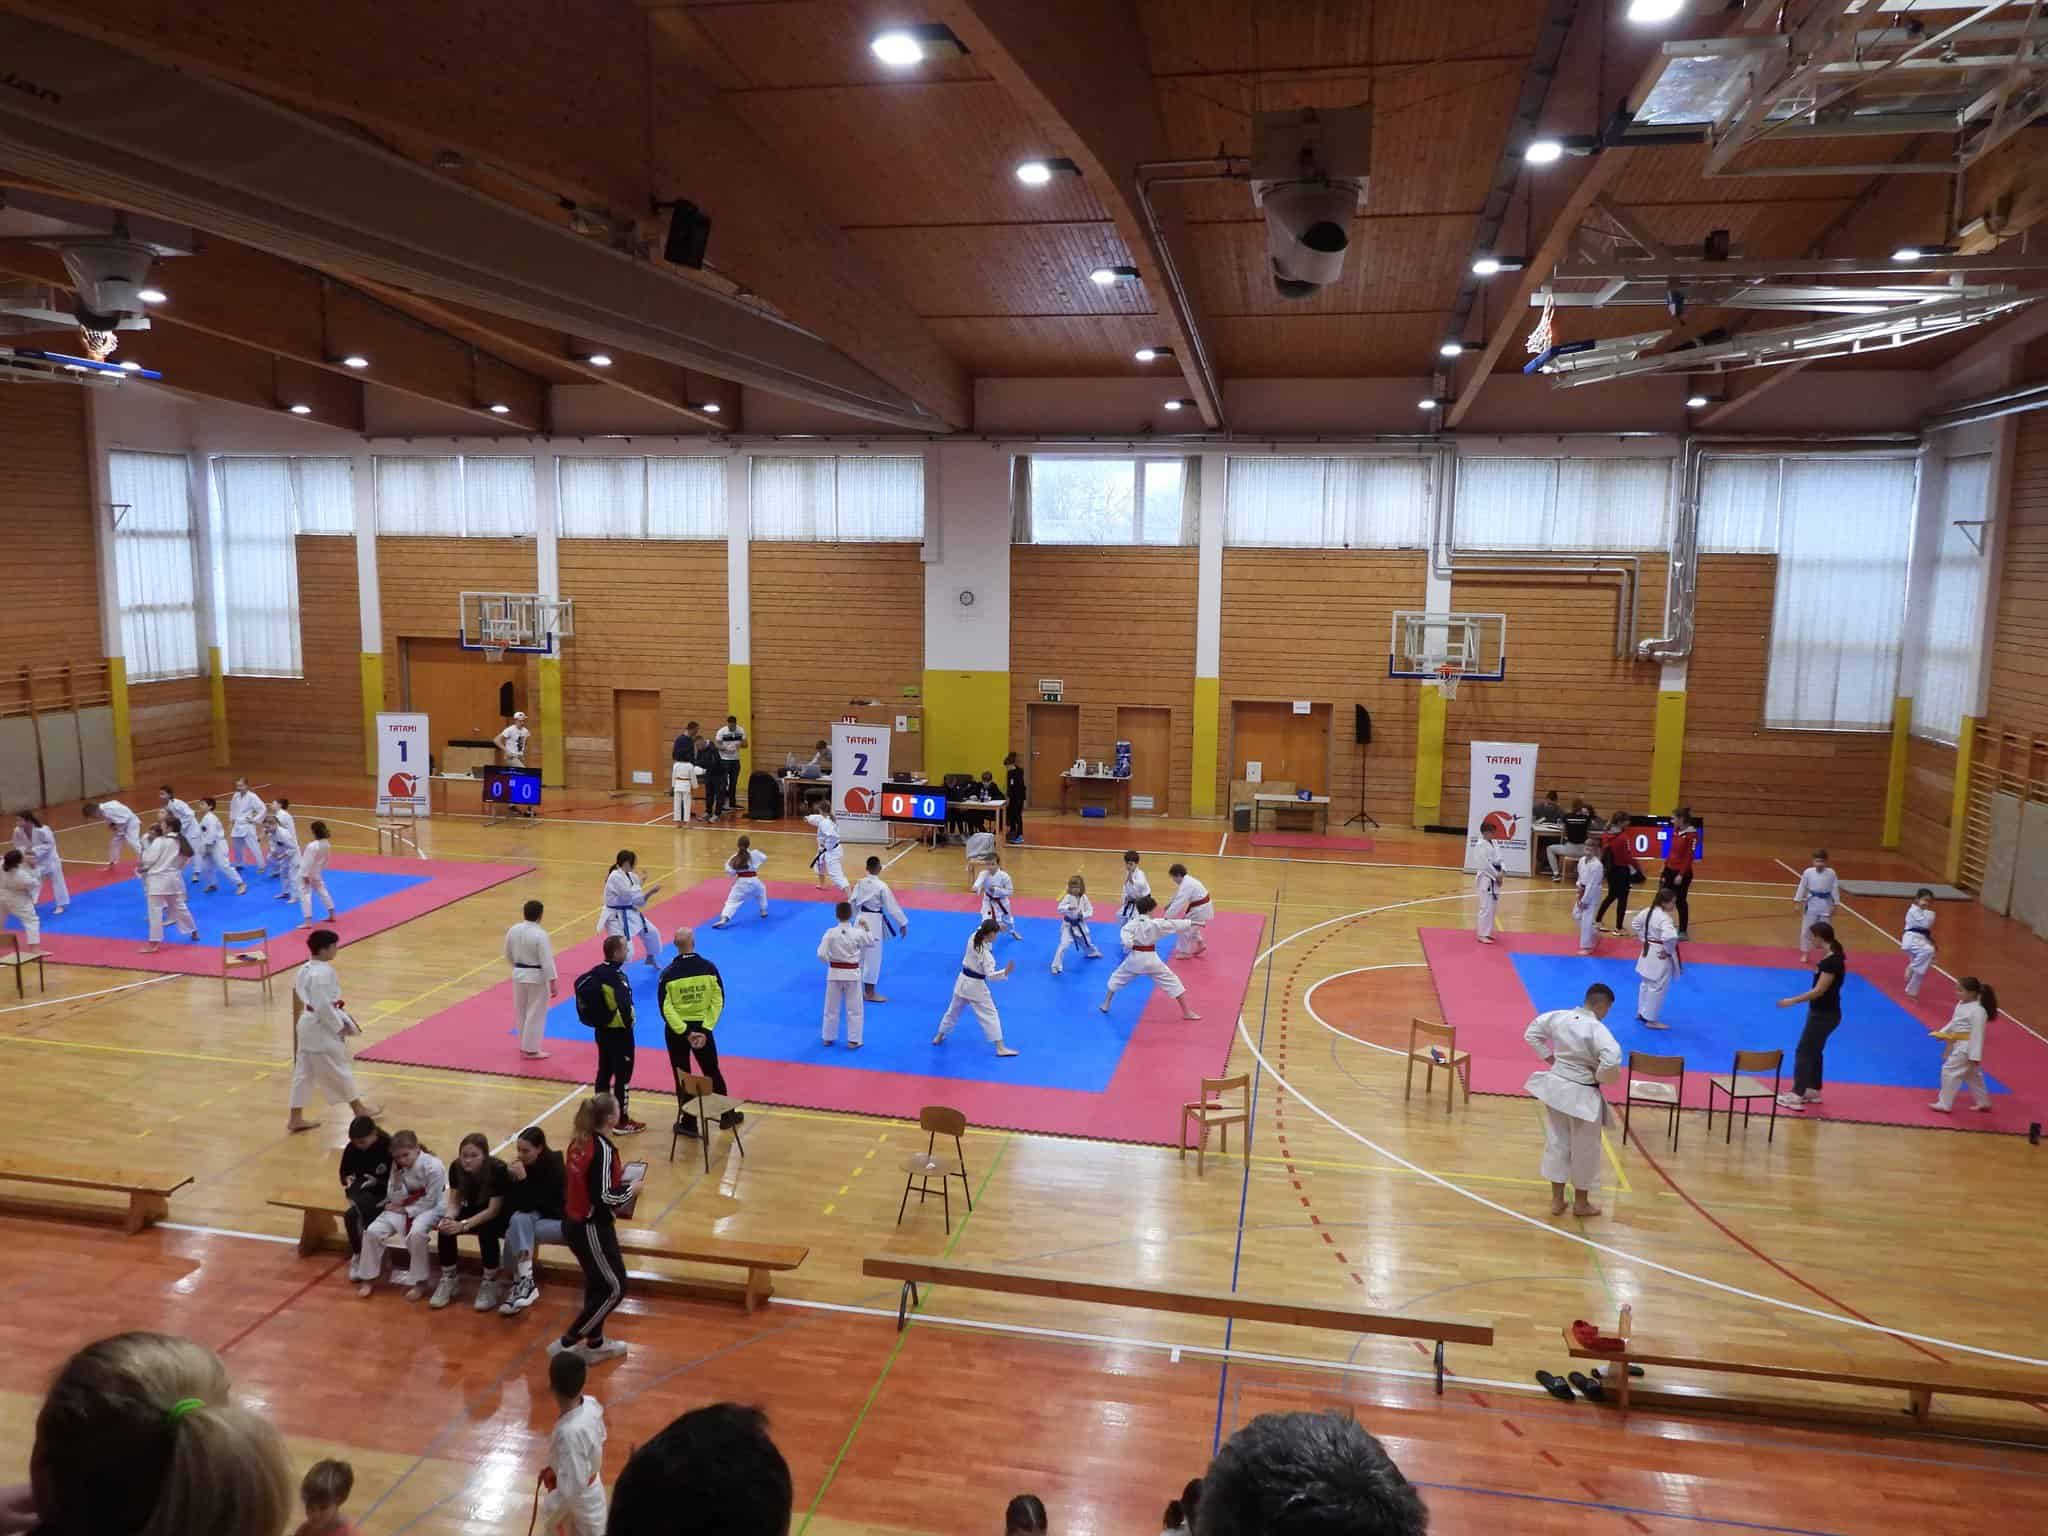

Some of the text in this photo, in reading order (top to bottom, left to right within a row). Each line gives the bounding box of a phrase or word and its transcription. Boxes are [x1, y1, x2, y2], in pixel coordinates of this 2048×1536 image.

[388, 725, 417, 733] TATAMI
[846, 736, 877, 745] TATAMI
[397, 740, 408, 762] 1
[1485, 755, 1521, 765] TATAMI
[853, 753, 868, 776] 2
[492, 782, 532, 799] 0 0
[1493, 774, 1511, 799] 3
[892, 796, 935, 816] 0 0
[1635, 834, 1648, 852] 0
